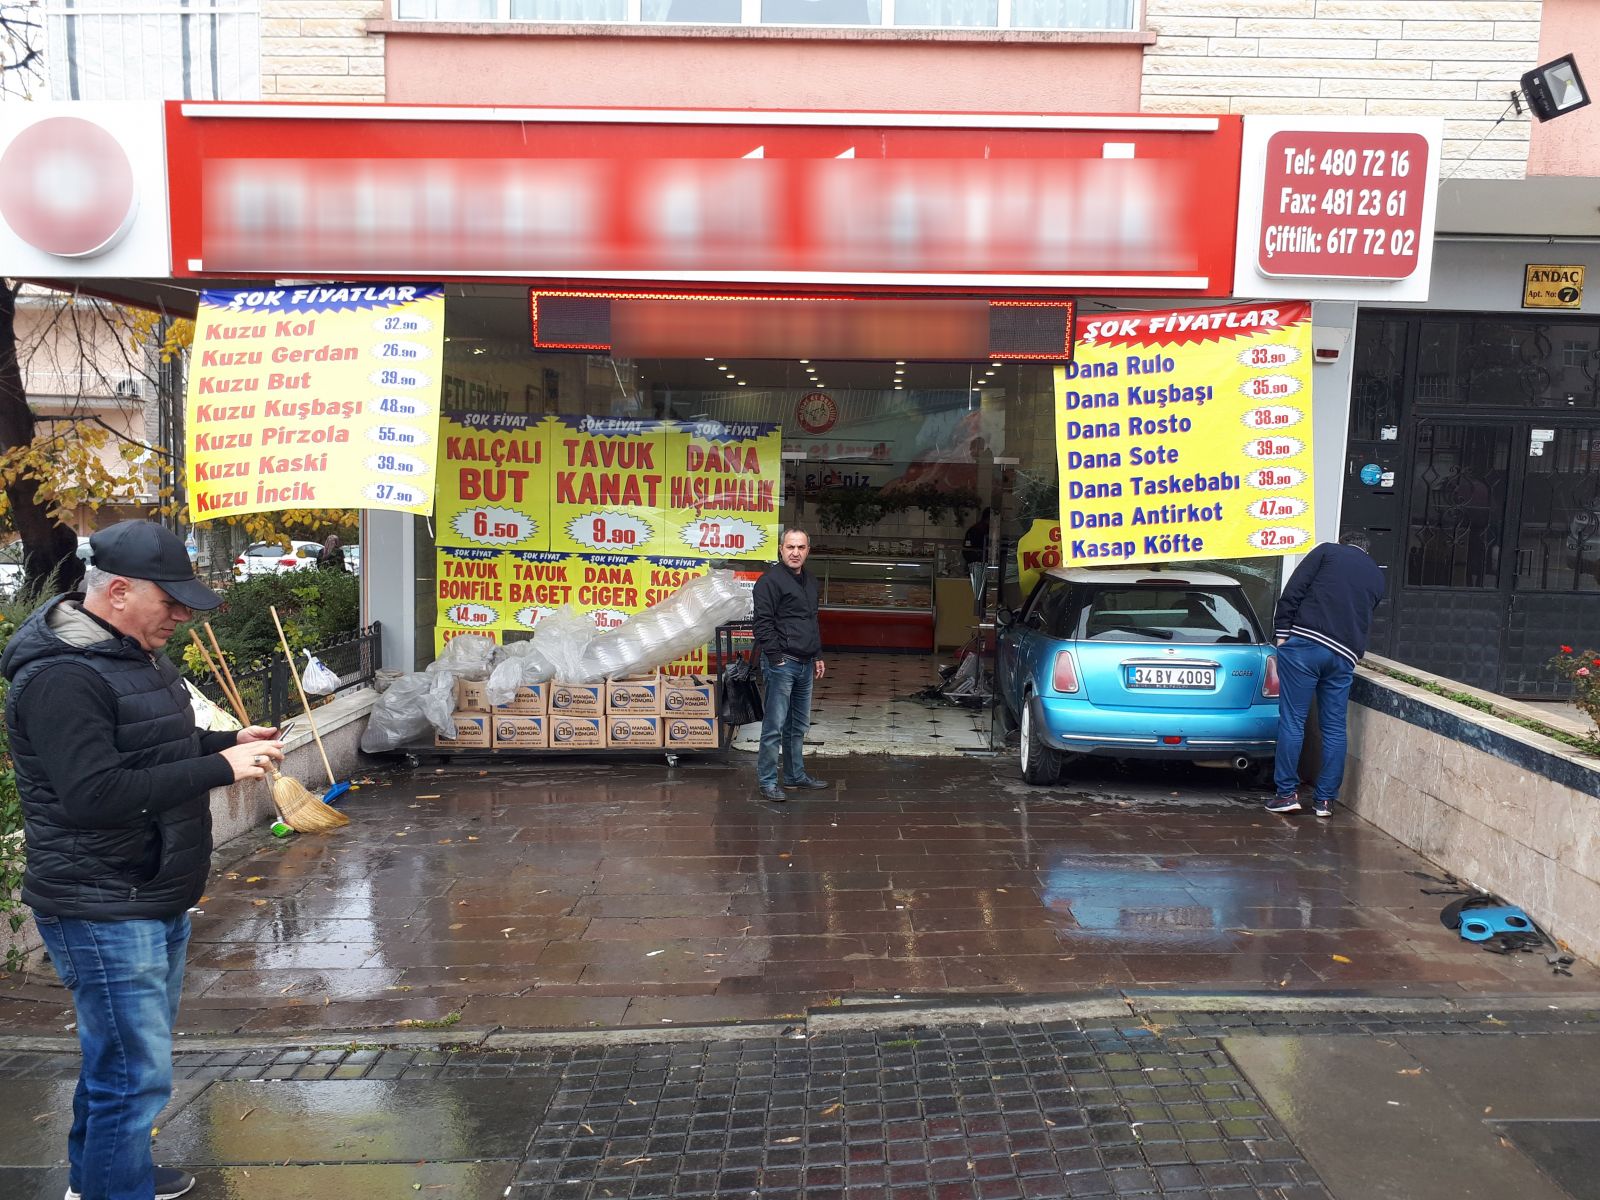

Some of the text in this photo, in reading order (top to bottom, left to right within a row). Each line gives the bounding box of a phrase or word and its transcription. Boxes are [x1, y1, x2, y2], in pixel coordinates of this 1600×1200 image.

[1284, 148, 1409, 177] Tel: 480 72 16
[1280, 187, 1406, 216] Fax: 481 23 61
[1265, 226, 1414, 258] Çiftlik: 617 72 02
[1530, 271, 1578, 285] ANDAÇ
[229, 284, 417, 312] ŞOK FİYATLAR
[1564, 289, 1573, 302] 7
[205, 317, 418, 341] Kuzu Kol 32.90
[1083, 309, 1280, 343] ŞOK FİYATLAR
[201, 344, 417, 367] Kuzu Gerdan 26.90
[1064, 350, 1286, 380] Dana Rulo 33.90
[198, 371, 416, 394] Kuzu But 39.90
[1066, 380, 1288, 410] Dana Kuşbaşı 35.90
[196, 404, 255, 423] Kuzu
[264, 399, 363, 419] Kuşbaşı
[464, 413, 528, 426] ŞOK FİYAT
[195, 432, 253, 452] Kuzu
[261, 425, 350, 446] Pirzola
[695, 423, 758, 437] ŞOK FİYAT
[1067, 410, 1288, 440] Dana Rosto 38.90
[446, 436, 542, 467] KALÇALI
[563, 439, 654, 470] TAVUK
[686, 444, 760, 474] DANA
[1068, 440, 1290, 470] Dana Sote 39.90
[195, 452, 413, 482] Kuzu Kaski 39.90
[197, 481, 412, 512] Kuzu İncik 37.90
[460, 468, 529, 502] BUT
[556, 472, 662, 508] KANAT
[670, 476, 774, 517] HAŞLAMALIK
[1069, 470, 1291, 500] Dana Taskebabı 39.90
[474, 512, 518, 538] 6.50
[1070, 501, 1292, 528] Dana Antirkot 47.90
[592, 518, 636, 544] 9.90
[699, 523, 744, 548] 23.00
[1071, 530, 1294, 559] Kasap Köfte 32.90
[454, 549, 470, 558] ŞOK
[523, 552, 538, 560] ŞOK
[590, 555, 606, 564] ŞOK
[658, 559, 674, 568] ŞOK
[444, 561, 498, 579] TAVUK
[513, 564, 568, 582] TAVUK
[585, 567, 634, 585] DANA
[510, 584, 572, 604] BAGET
[1136, 670, 1212, 684] 34 BV 4009
